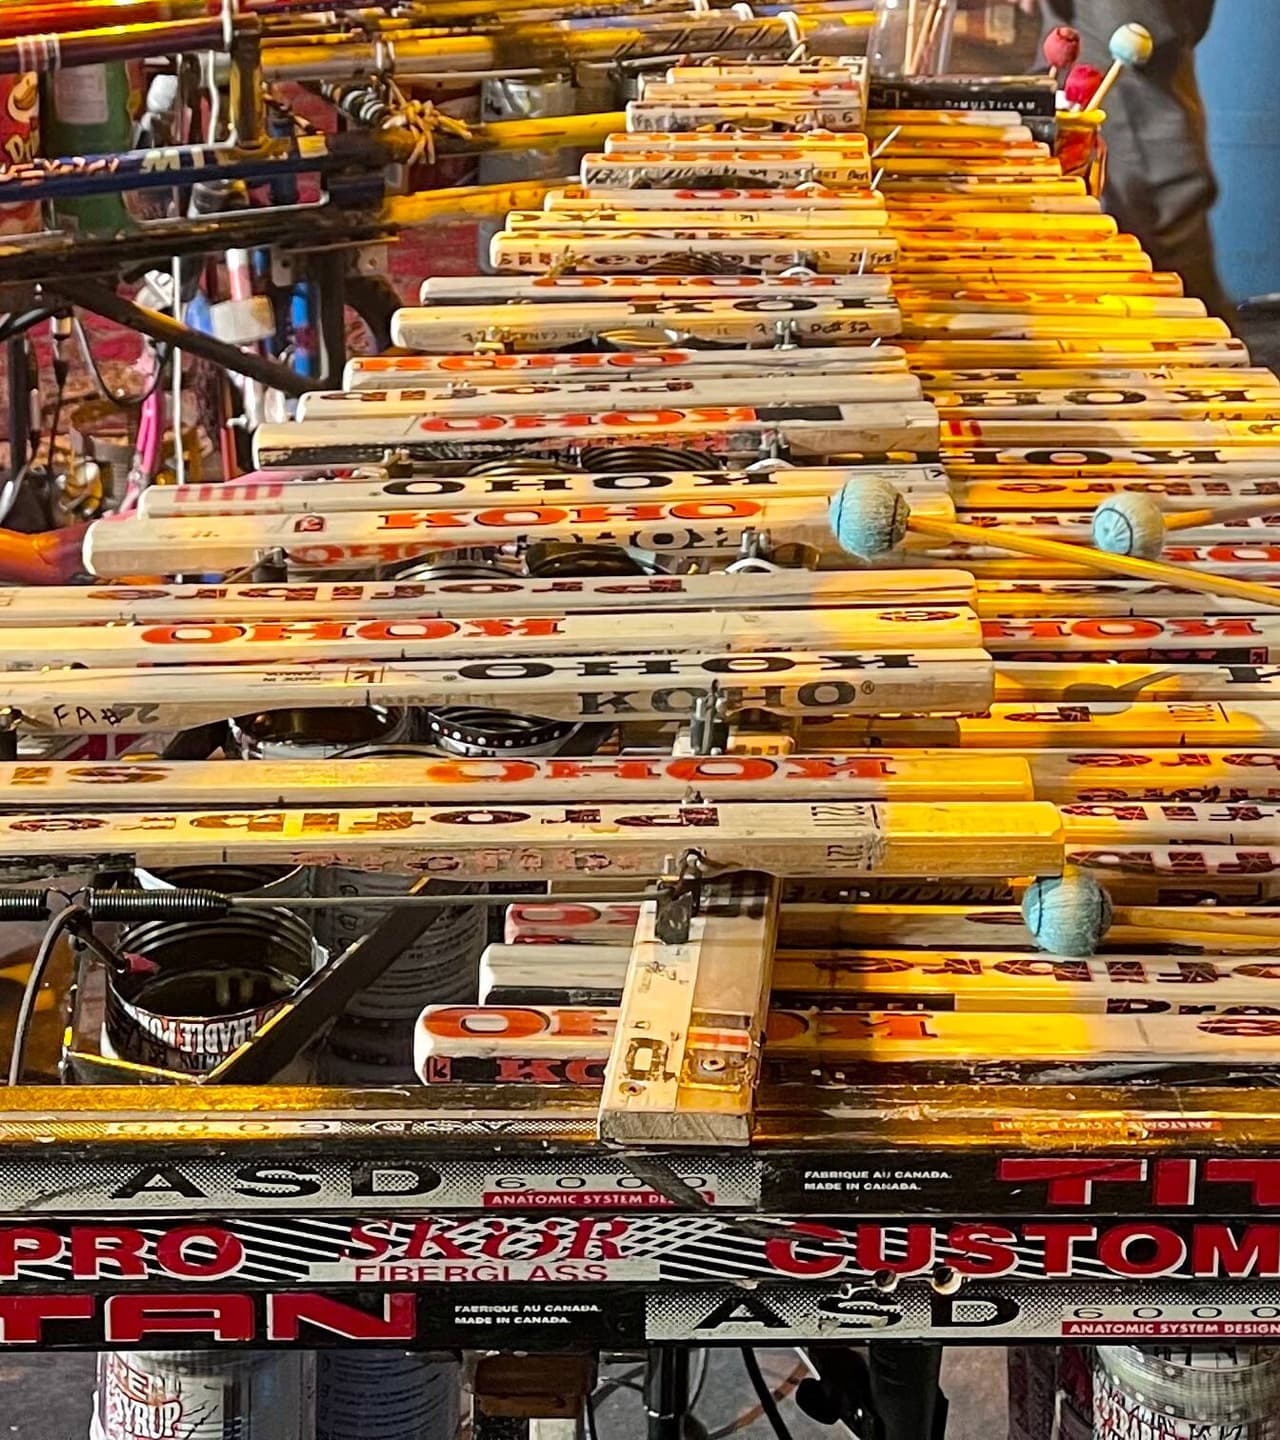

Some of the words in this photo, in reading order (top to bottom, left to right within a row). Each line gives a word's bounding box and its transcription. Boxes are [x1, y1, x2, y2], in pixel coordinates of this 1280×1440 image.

[422, 406, 757, 433] KOHO
[382, 474, 778, 496] KOHO
[376, 500, 763, 530] KOHO
[141, 617, 567, 645] KOHO
[457, 653, 920, 680] KOHO
[426, 756, 898, 784] KOHO
[111, 1163, 443, 1200] ASD
[804, 1182, 840, 1191] MADE
[491, 1192, 580, 1206] ANATOMIC
[582, 1192, 644, 1205] SYSTEM
[355, 1264, 609, 1282] FIBERGLASS
[454, 1316, 490, 1325] MADE
[694, 1297, 1021, 1330] ASD
[1068, 1322, 1155, 1336] ANATOMIC
[1159, 1322, 1218, 1335] SYSTEM
